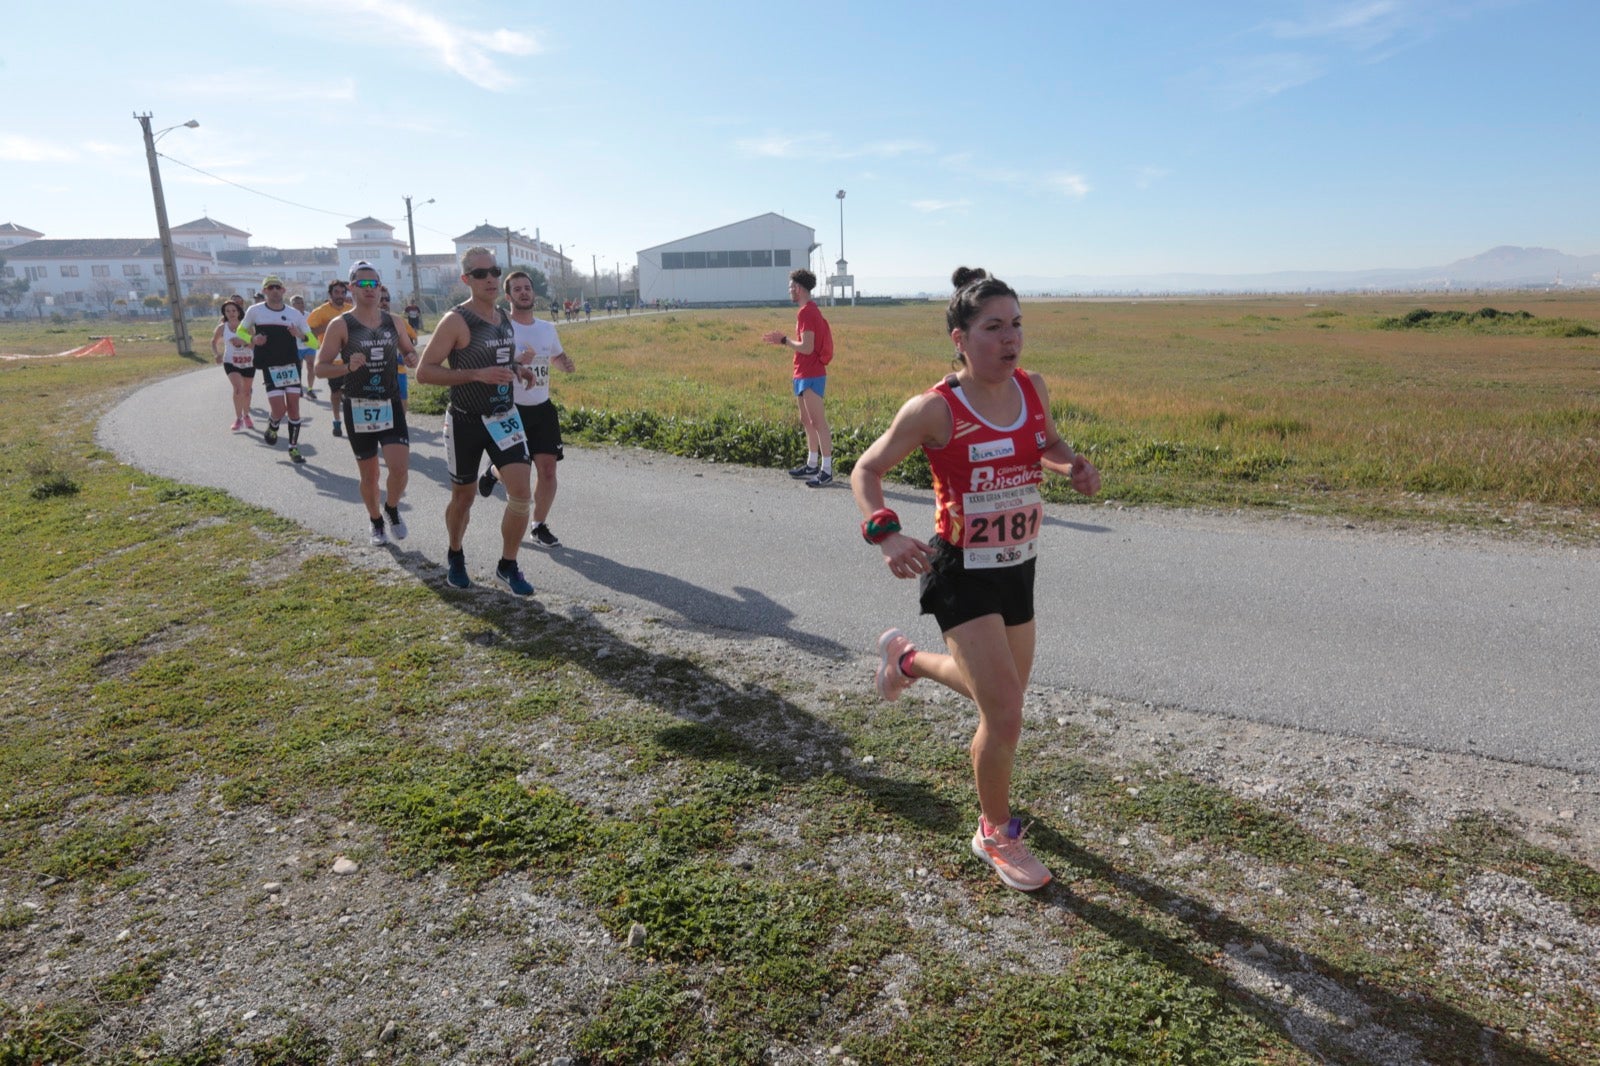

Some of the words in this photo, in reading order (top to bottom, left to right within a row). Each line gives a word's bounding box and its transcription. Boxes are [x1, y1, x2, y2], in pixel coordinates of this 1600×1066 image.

[276, 370, 293, 380] 497
[364, 408, 381, 421] 57
[500, 417, 519, 434] 56
[969, 508, 1038, 543] 2181
